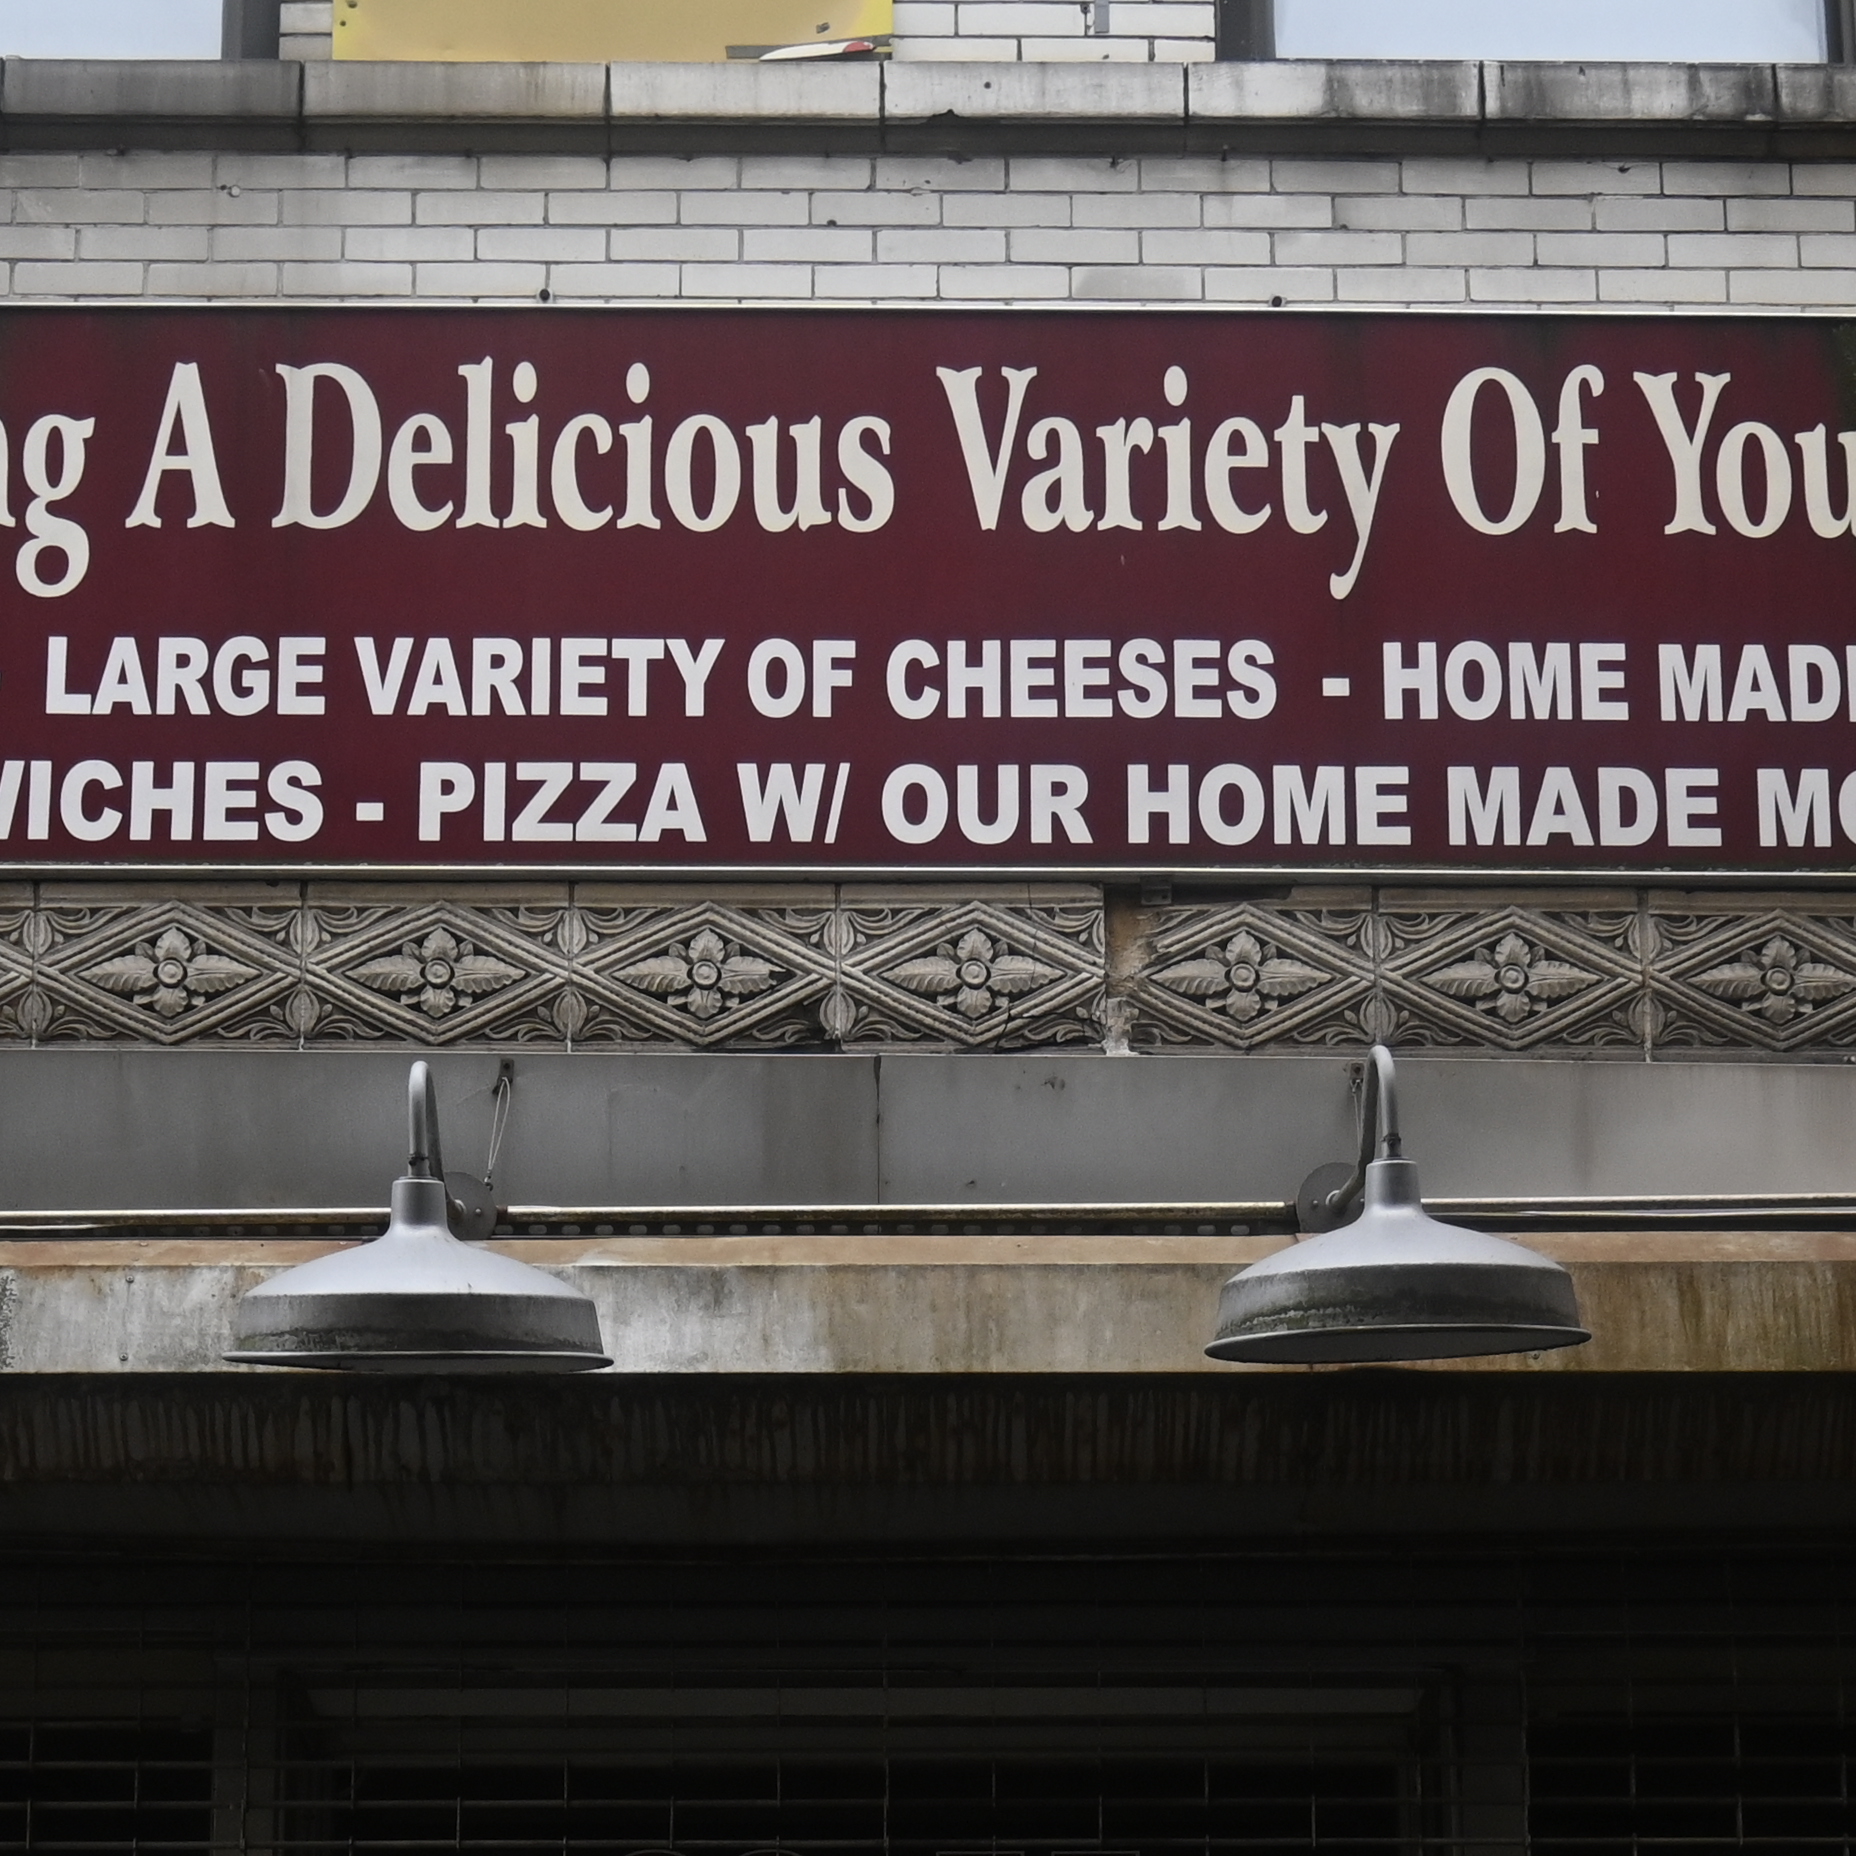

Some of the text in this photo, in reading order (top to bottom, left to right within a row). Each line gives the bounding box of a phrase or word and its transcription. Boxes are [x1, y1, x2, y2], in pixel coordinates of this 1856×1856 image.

[125, 362, 235, 528] A
[272, 356, 894, 532] Delicious
[936, 366, 1400, 599] Variety
[1441, 365, 1604, 535] Of
[46, 636, 326, 716] LARGE
[354, 637, 725, 716] VARIETY
[748, 638, 856, 718] OF
[887, 638, 1276, 719] CHEESES
[1383, 641, 1629, 720] HOME
[419, 762, 707, 842] PIZZA
[737, 763, 850, 843] W/
[882, 764, 1093, 844] OUR
[1128, 764, 1411, 845] HOME
[1447, 767, 1721, 846] MADE
